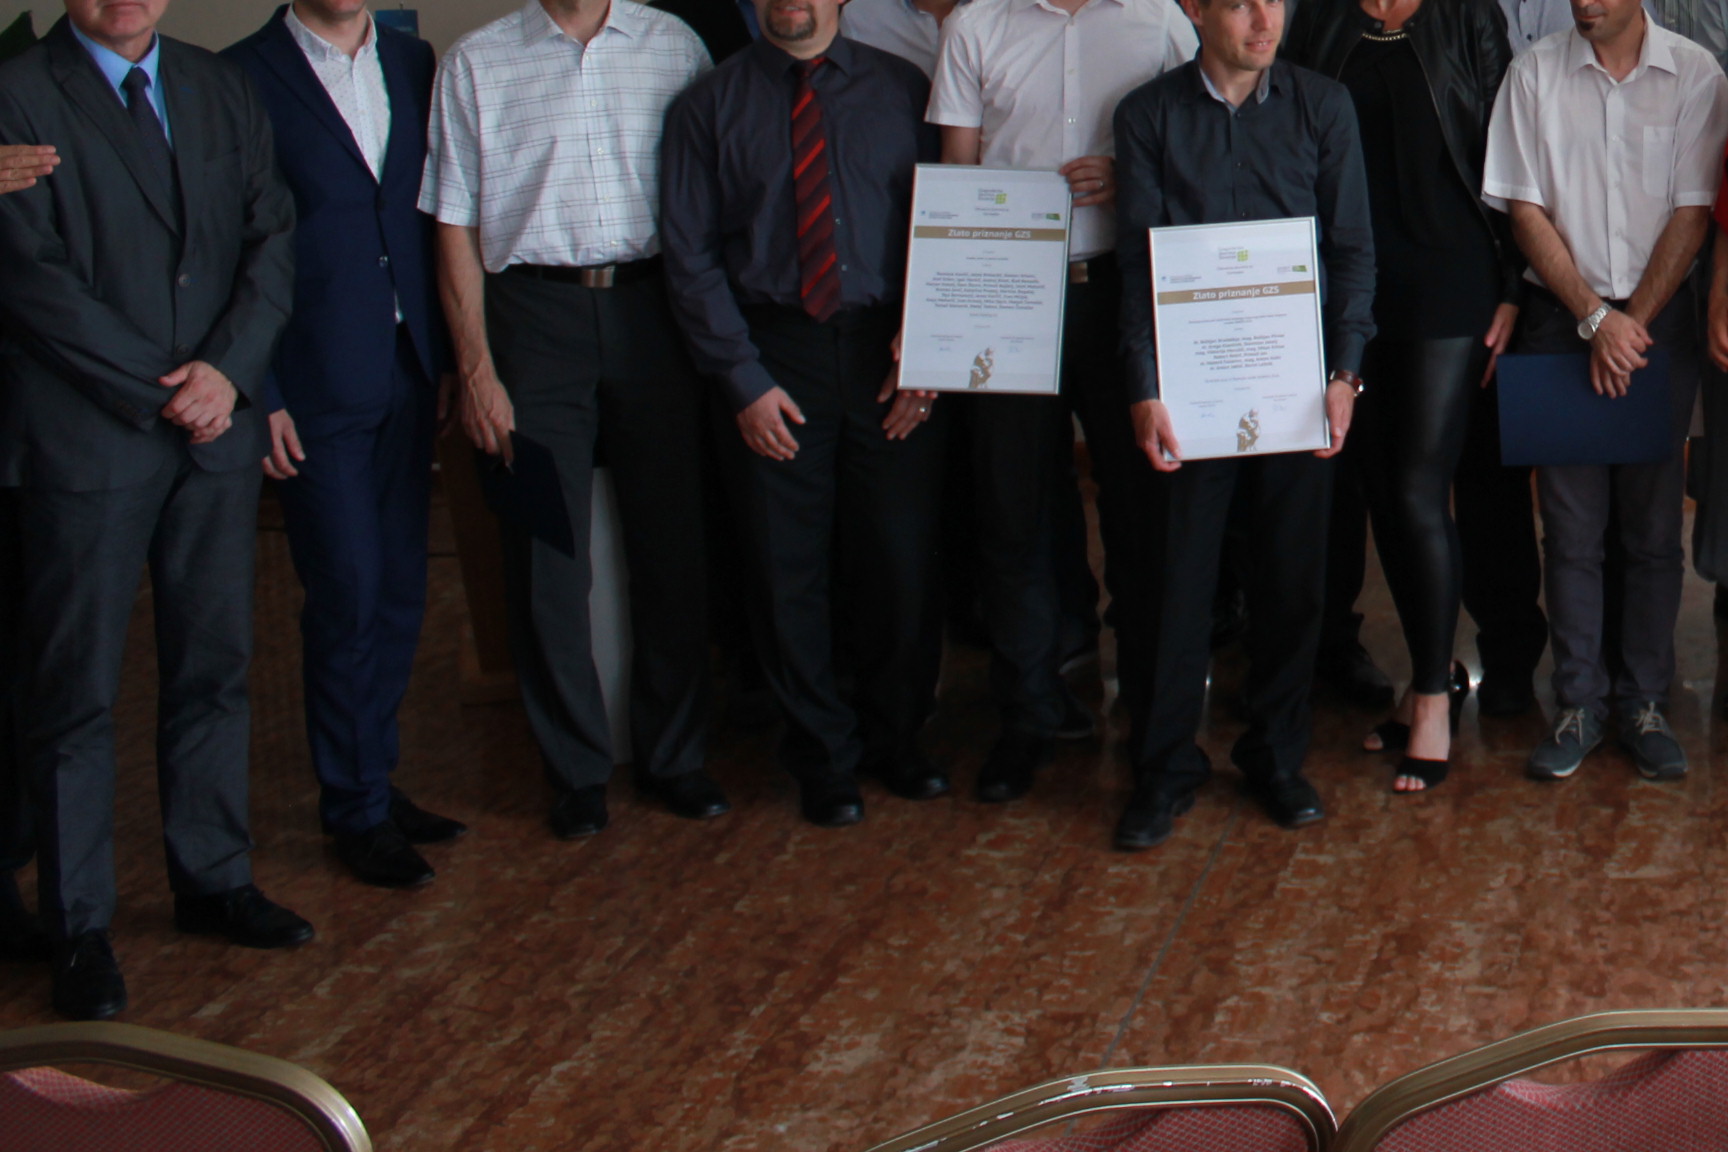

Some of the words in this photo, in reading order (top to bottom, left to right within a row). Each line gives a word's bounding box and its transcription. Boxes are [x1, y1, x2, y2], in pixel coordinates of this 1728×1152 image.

[948, 229, 971, 238] Zlato
[972, 230, 1013, 240] priznanje
[1015, 231, 1031, 239] GZS
[1193, 290, 1217, 300] Zlato
[1218, 287, 1261, 299] priznanje
[1262, 286, 1280, 294] GZS
